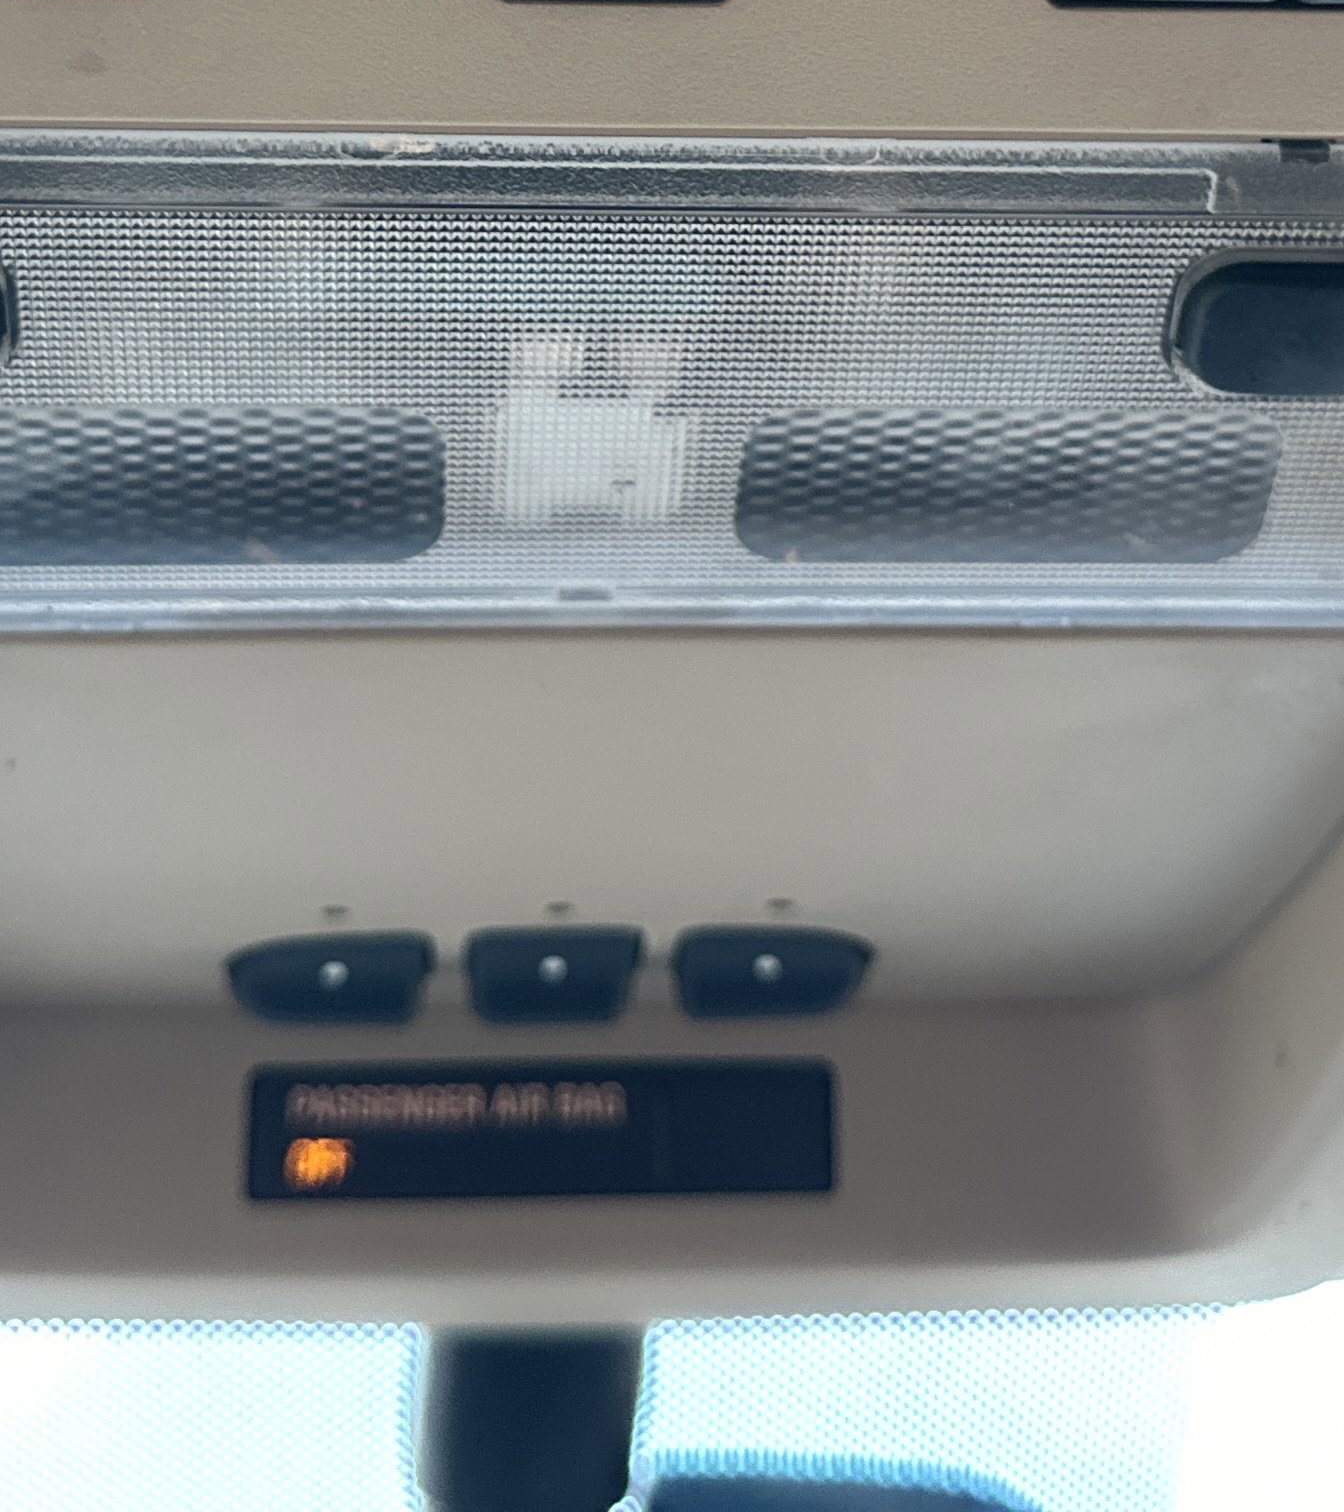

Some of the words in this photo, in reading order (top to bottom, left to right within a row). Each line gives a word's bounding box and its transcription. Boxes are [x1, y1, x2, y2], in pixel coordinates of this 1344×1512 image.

[288, 1083, 486, 1124] PASSENGER
[493, 1082, 551, 1123] AIR
[556, 1081, 626, 1122] BAG
